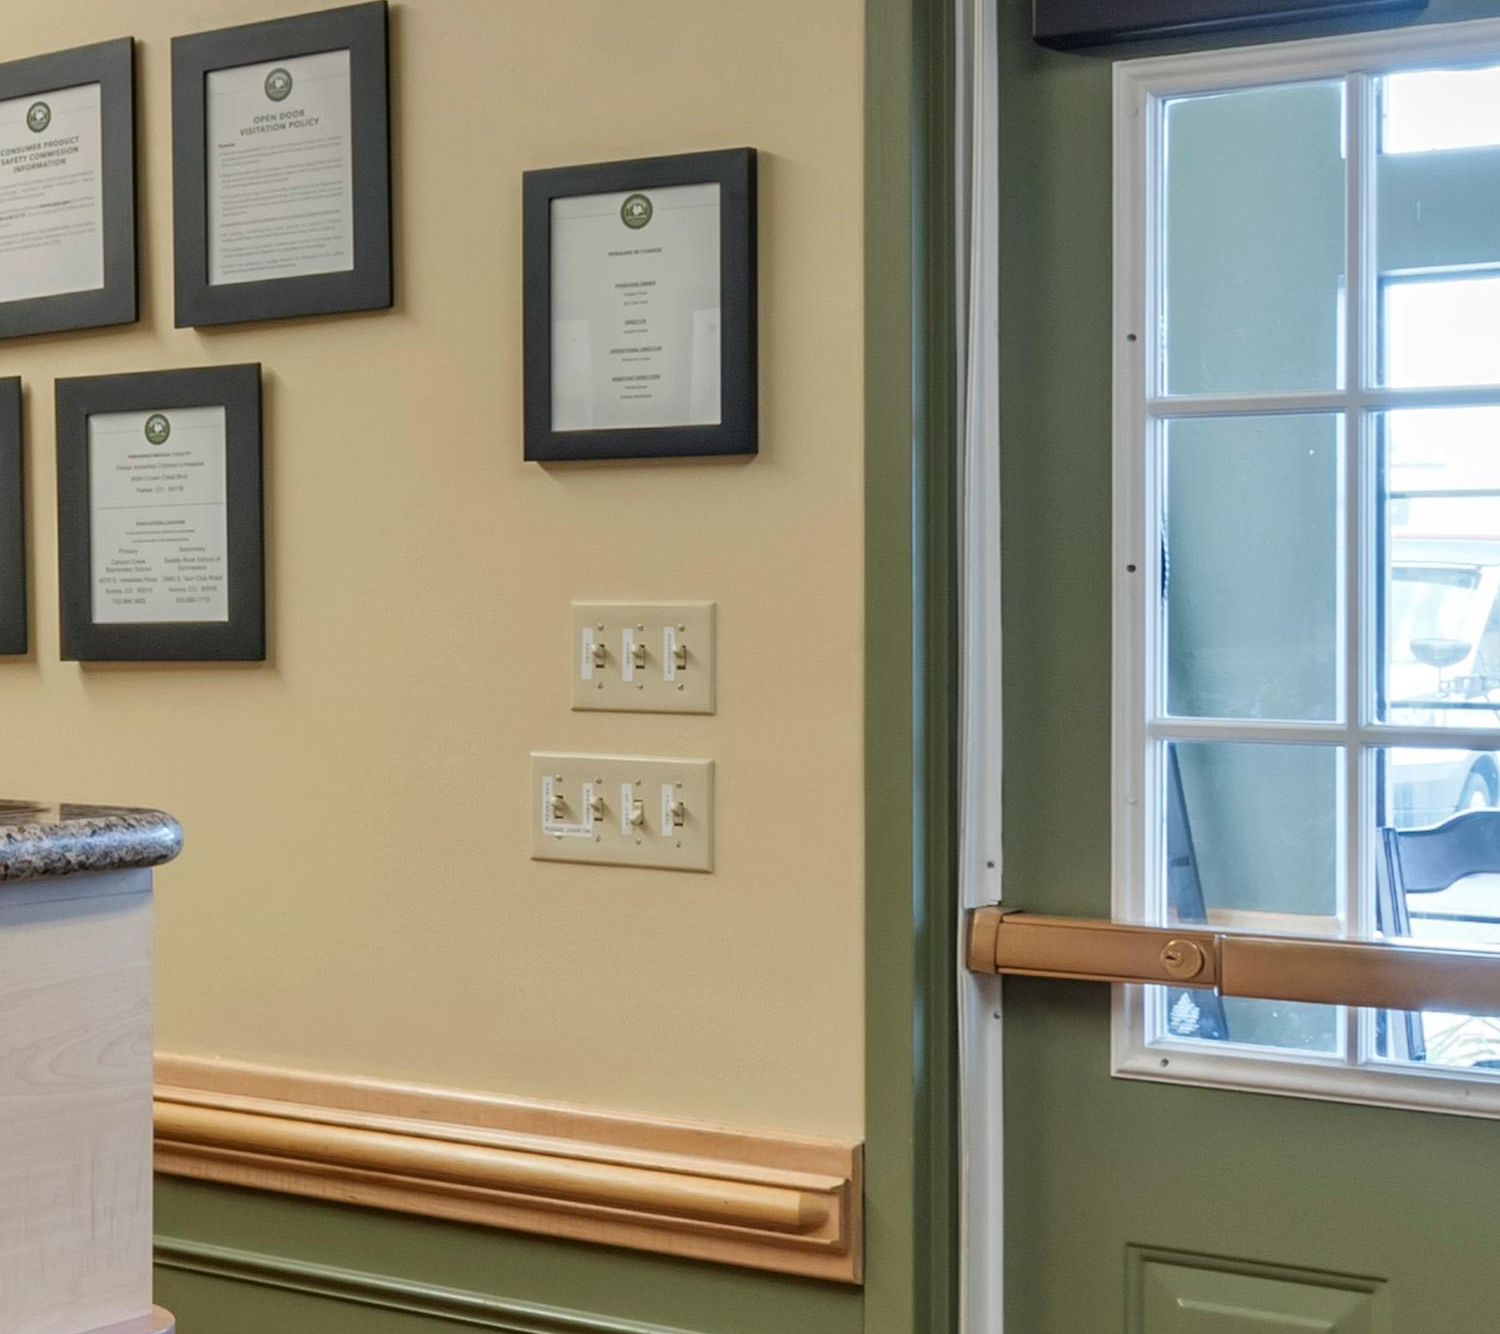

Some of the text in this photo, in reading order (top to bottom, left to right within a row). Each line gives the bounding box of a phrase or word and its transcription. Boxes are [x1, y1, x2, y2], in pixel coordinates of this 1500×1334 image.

[253, 109, 305, 123] OPEN DOOR
[240, 118, 319, 137] VISITATION POLICY
[0, 136, 80, 157] CONSUMER PRODUCT
[1, 146, 79, 166] SAFETY COMMISSION
[13, 158, 66, 173] INFORMATION
